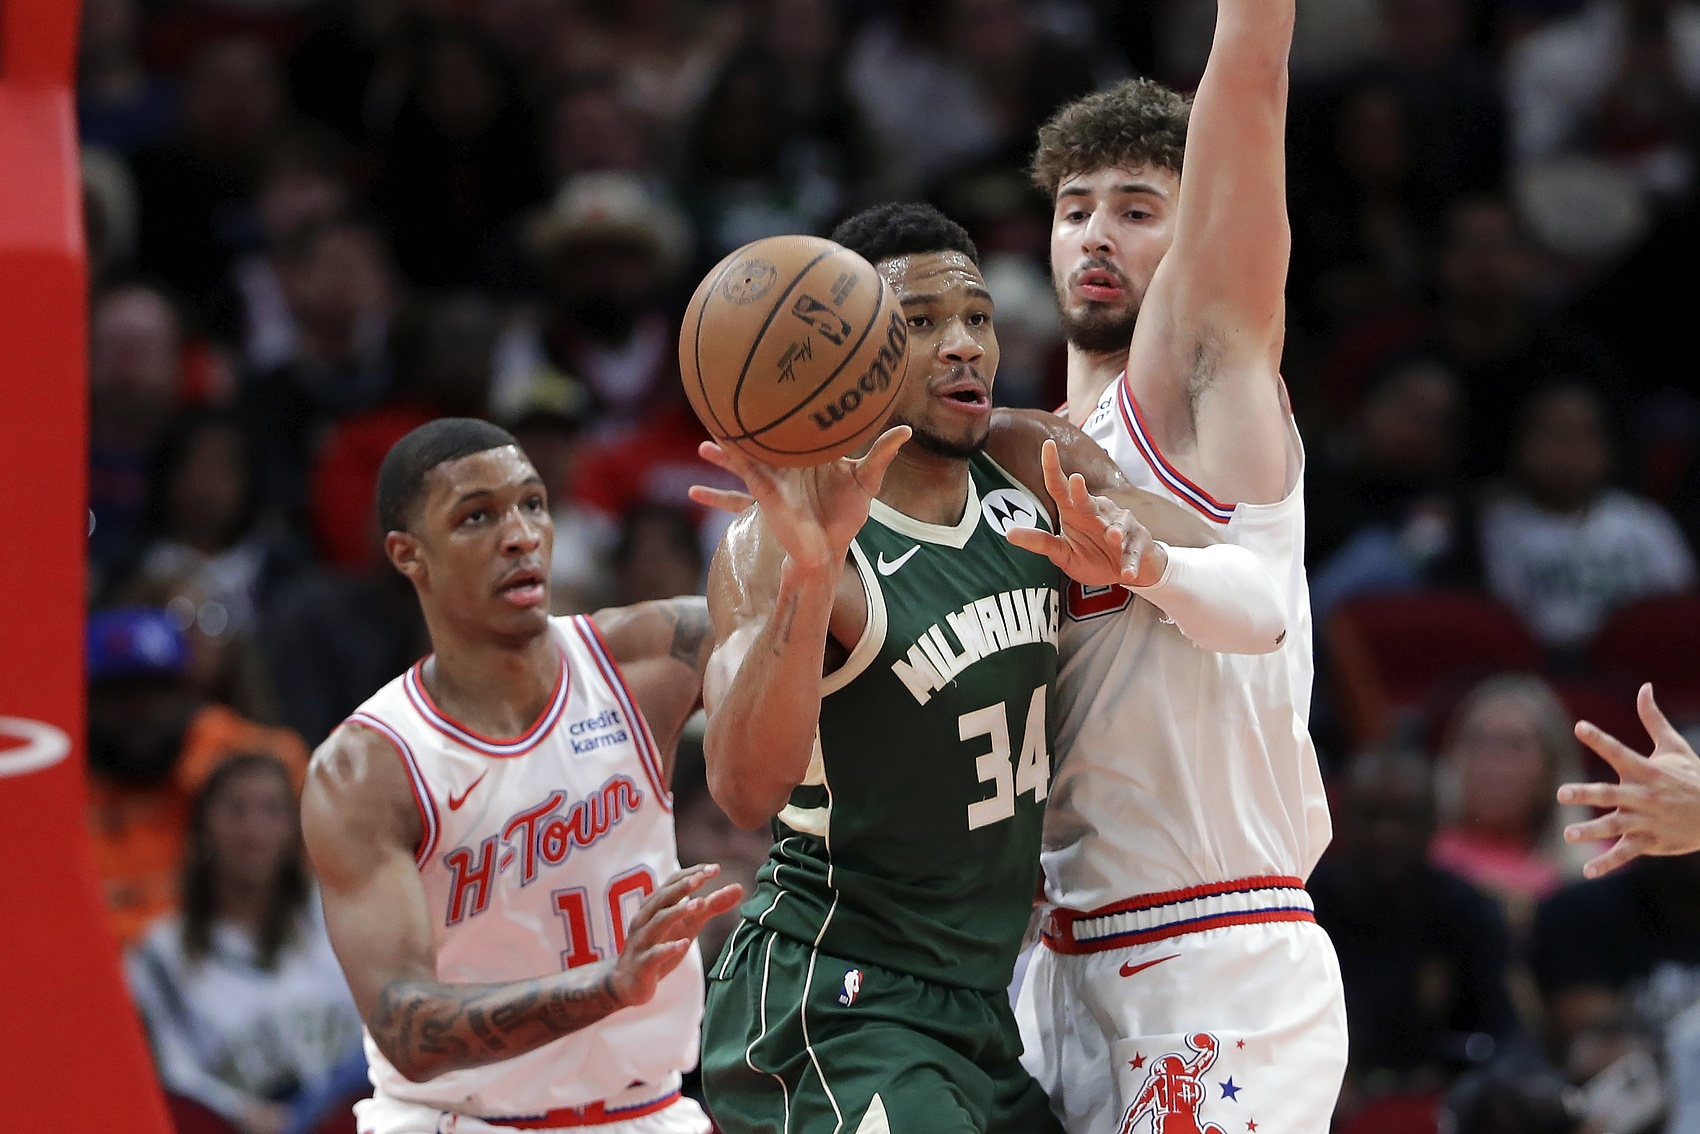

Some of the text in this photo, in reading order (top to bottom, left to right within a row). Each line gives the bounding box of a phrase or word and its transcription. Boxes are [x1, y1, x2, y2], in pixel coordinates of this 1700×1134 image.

[891, 588, 1059, 705] MILWAUKE
[570, 710, 620, 735] credit
[571, 730, 627, 754] karma
[958, 684, 1050, 830] 34
[443, 773, 643, 927] H-Town
